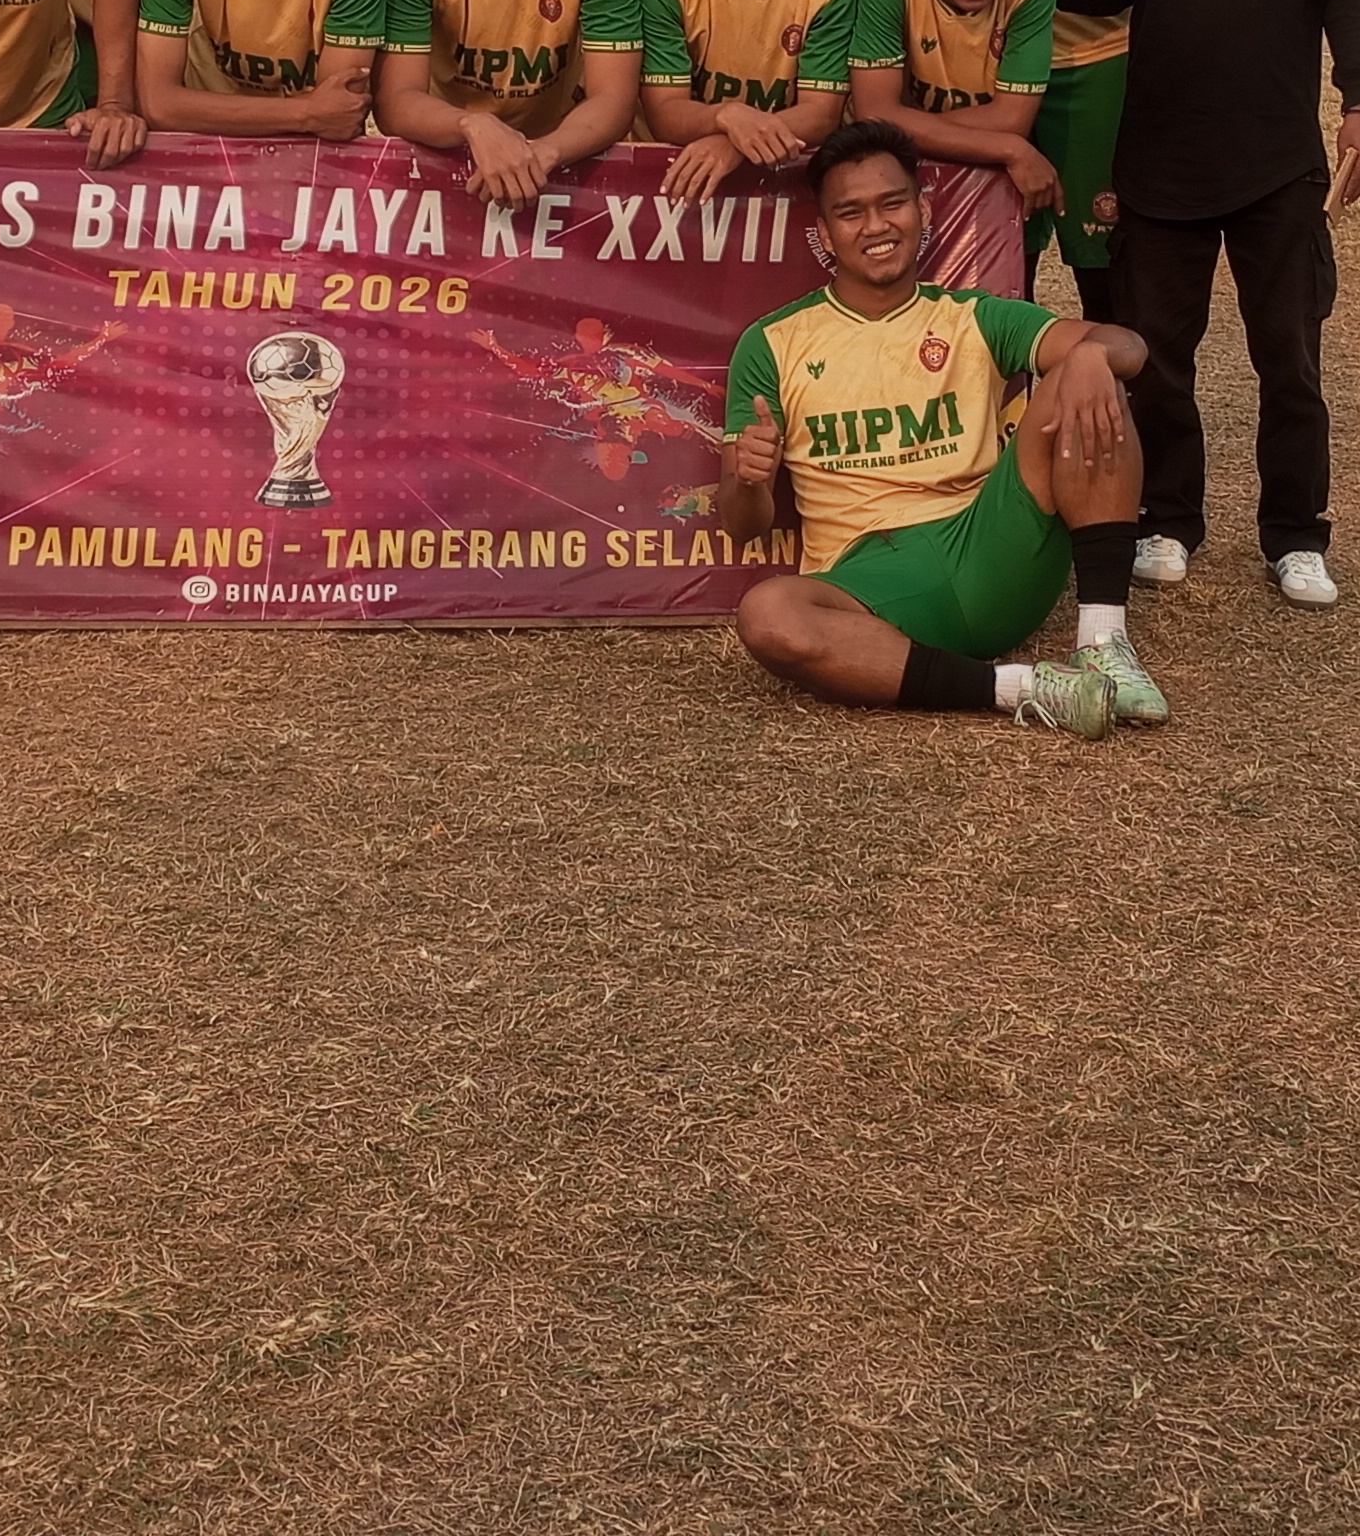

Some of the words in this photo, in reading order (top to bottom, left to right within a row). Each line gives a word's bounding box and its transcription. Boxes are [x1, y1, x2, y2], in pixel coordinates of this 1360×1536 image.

[149, 21, 178, 34] MUDA
[645, 74, 671, 84] MUDA
[816, 80, 834, 90] BOS
[1011, 83, 1029, 92] BOS
[72, 183, 246, 250] BINA
[281, 186, 445, 256] JAYA
[481, 194, 571, 259] KE
[596, 195, 790, 262] XXVII
[805, 227, 832, 268] FOOTBALL
[108, 270, 297, 310] TAHUN
[321, 274, 470, 314] 2026
[804, 391, 964, 458] HIPMI
[819, 455, 895, 472] TANGERANG
[899, 442, 959, 465] SELATAN
[8, 526, 265, 567] PAMULANG
[321, 528, 587, 568] TANGERANG
[225, 583, 399, 603] BINAJAYACUP
